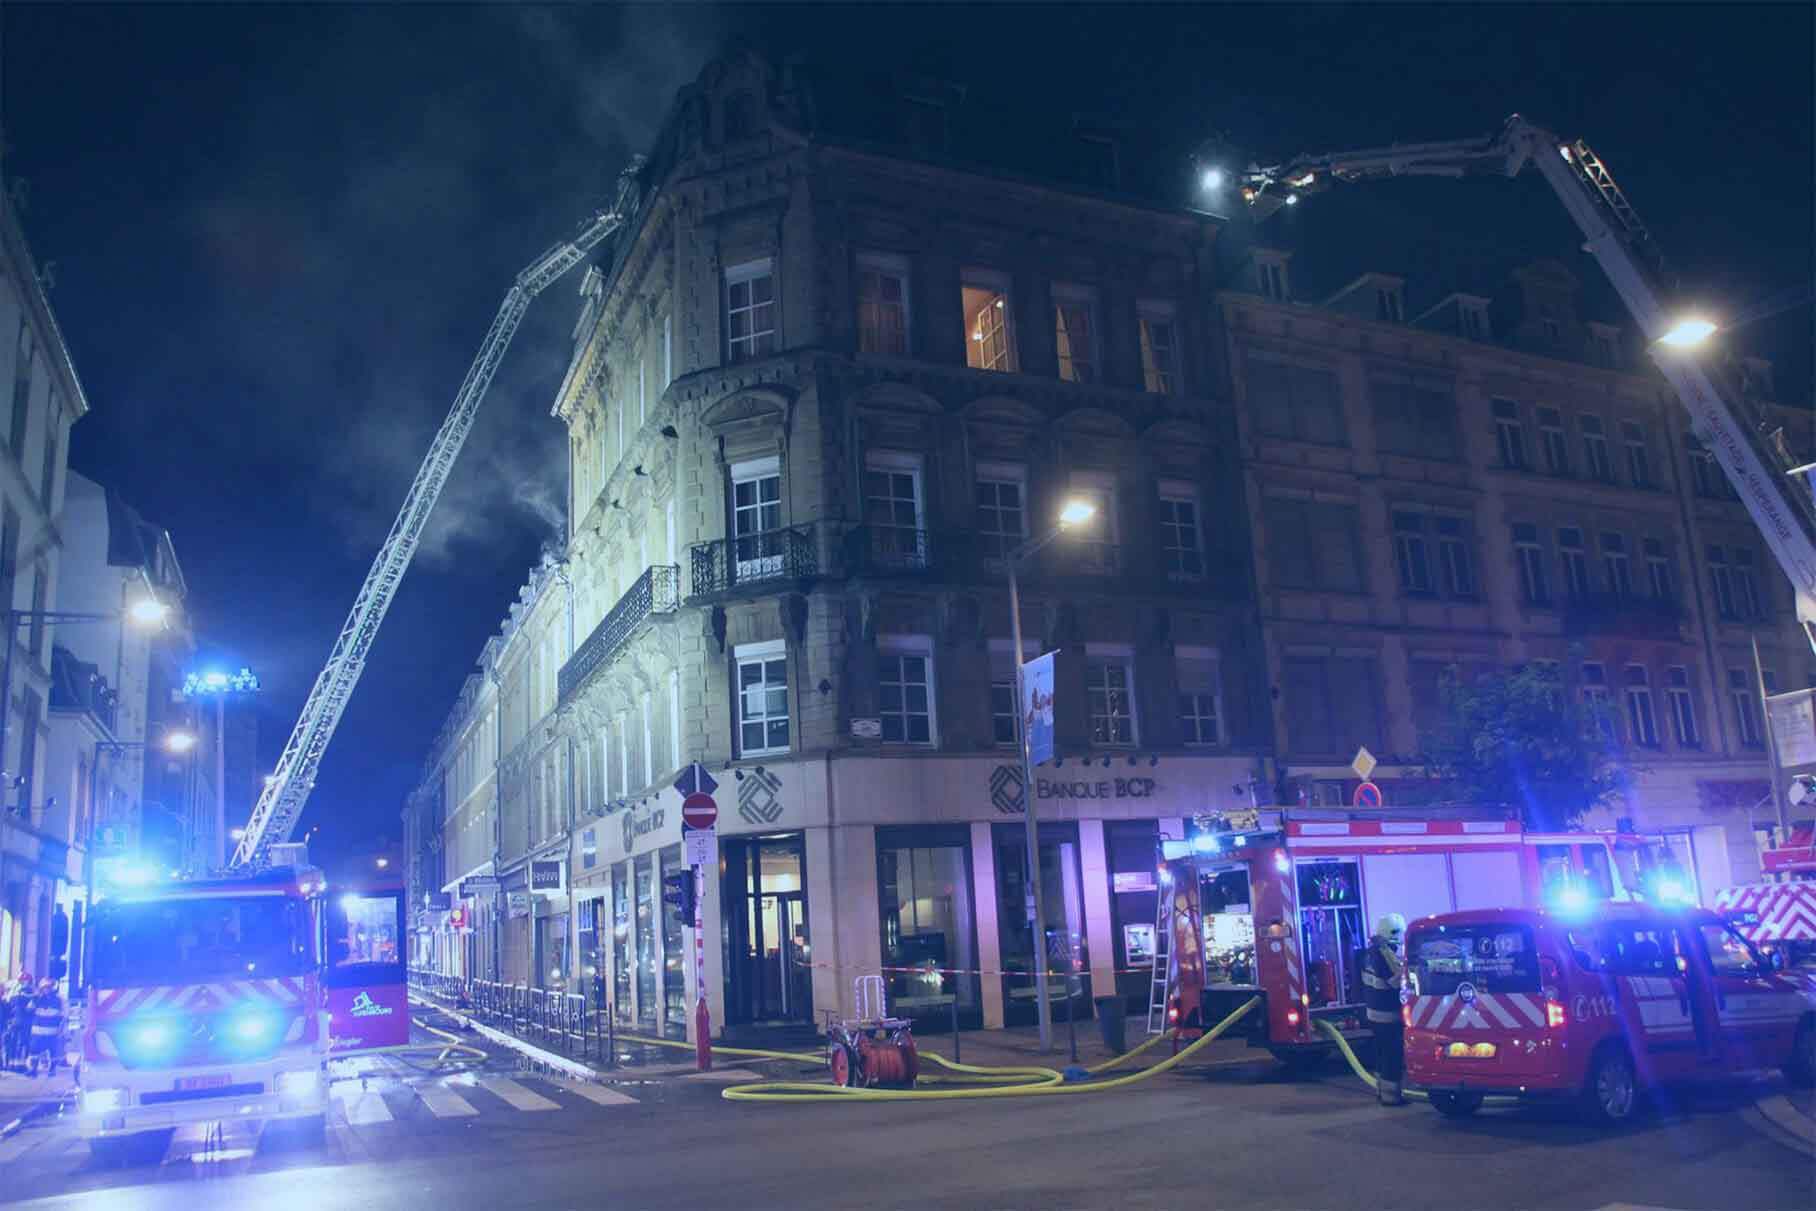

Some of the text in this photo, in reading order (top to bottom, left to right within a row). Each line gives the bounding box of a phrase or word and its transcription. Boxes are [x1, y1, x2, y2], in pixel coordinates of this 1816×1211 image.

[1748, 472, 1793, 541] HESPERANGE
[1036, 777, 1156, 799] BANQUE BCP
[1588, 996, 1618, 1017] 112
